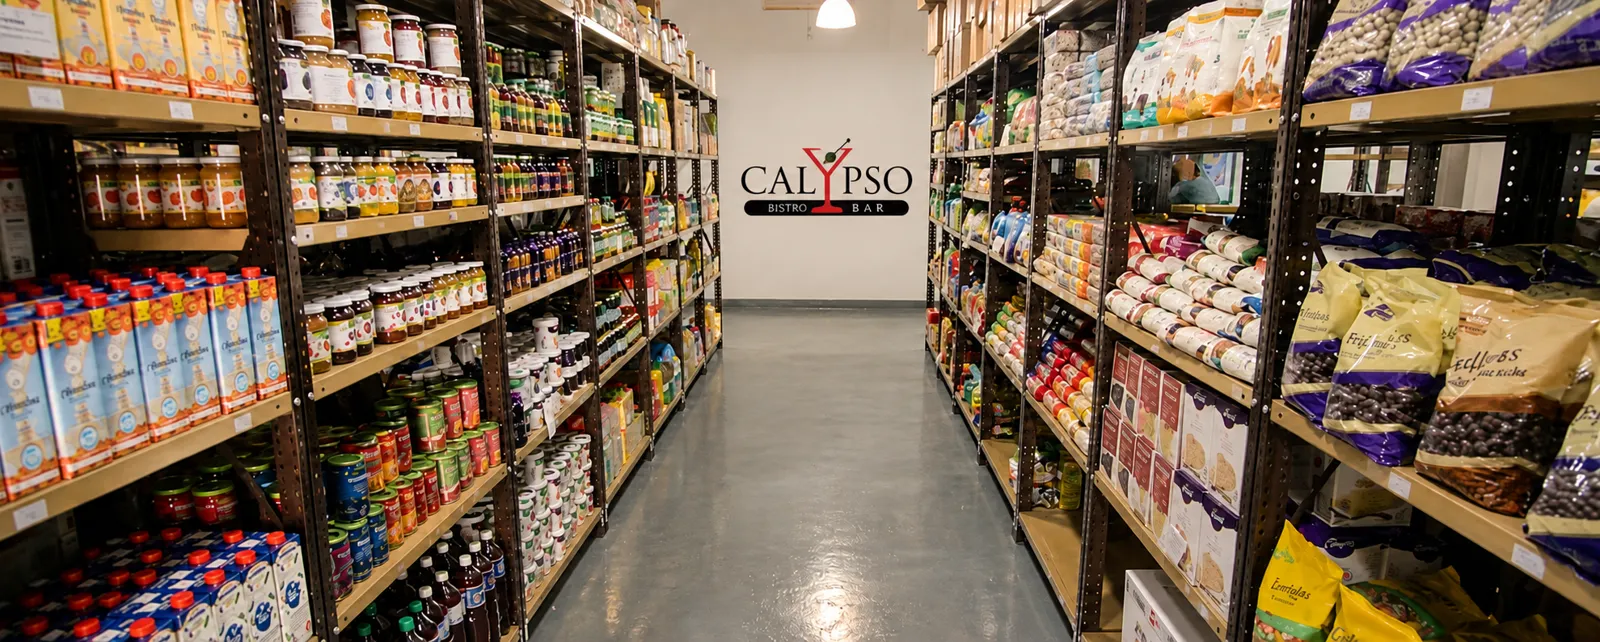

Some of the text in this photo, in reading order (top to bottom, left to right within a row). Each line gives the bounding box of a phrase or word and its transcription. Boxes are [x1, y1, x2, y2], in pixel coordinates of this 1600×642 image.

[741, 147, 913, 213] CALYPSO
[768, 203, 885, 213] BISTRO BAR
